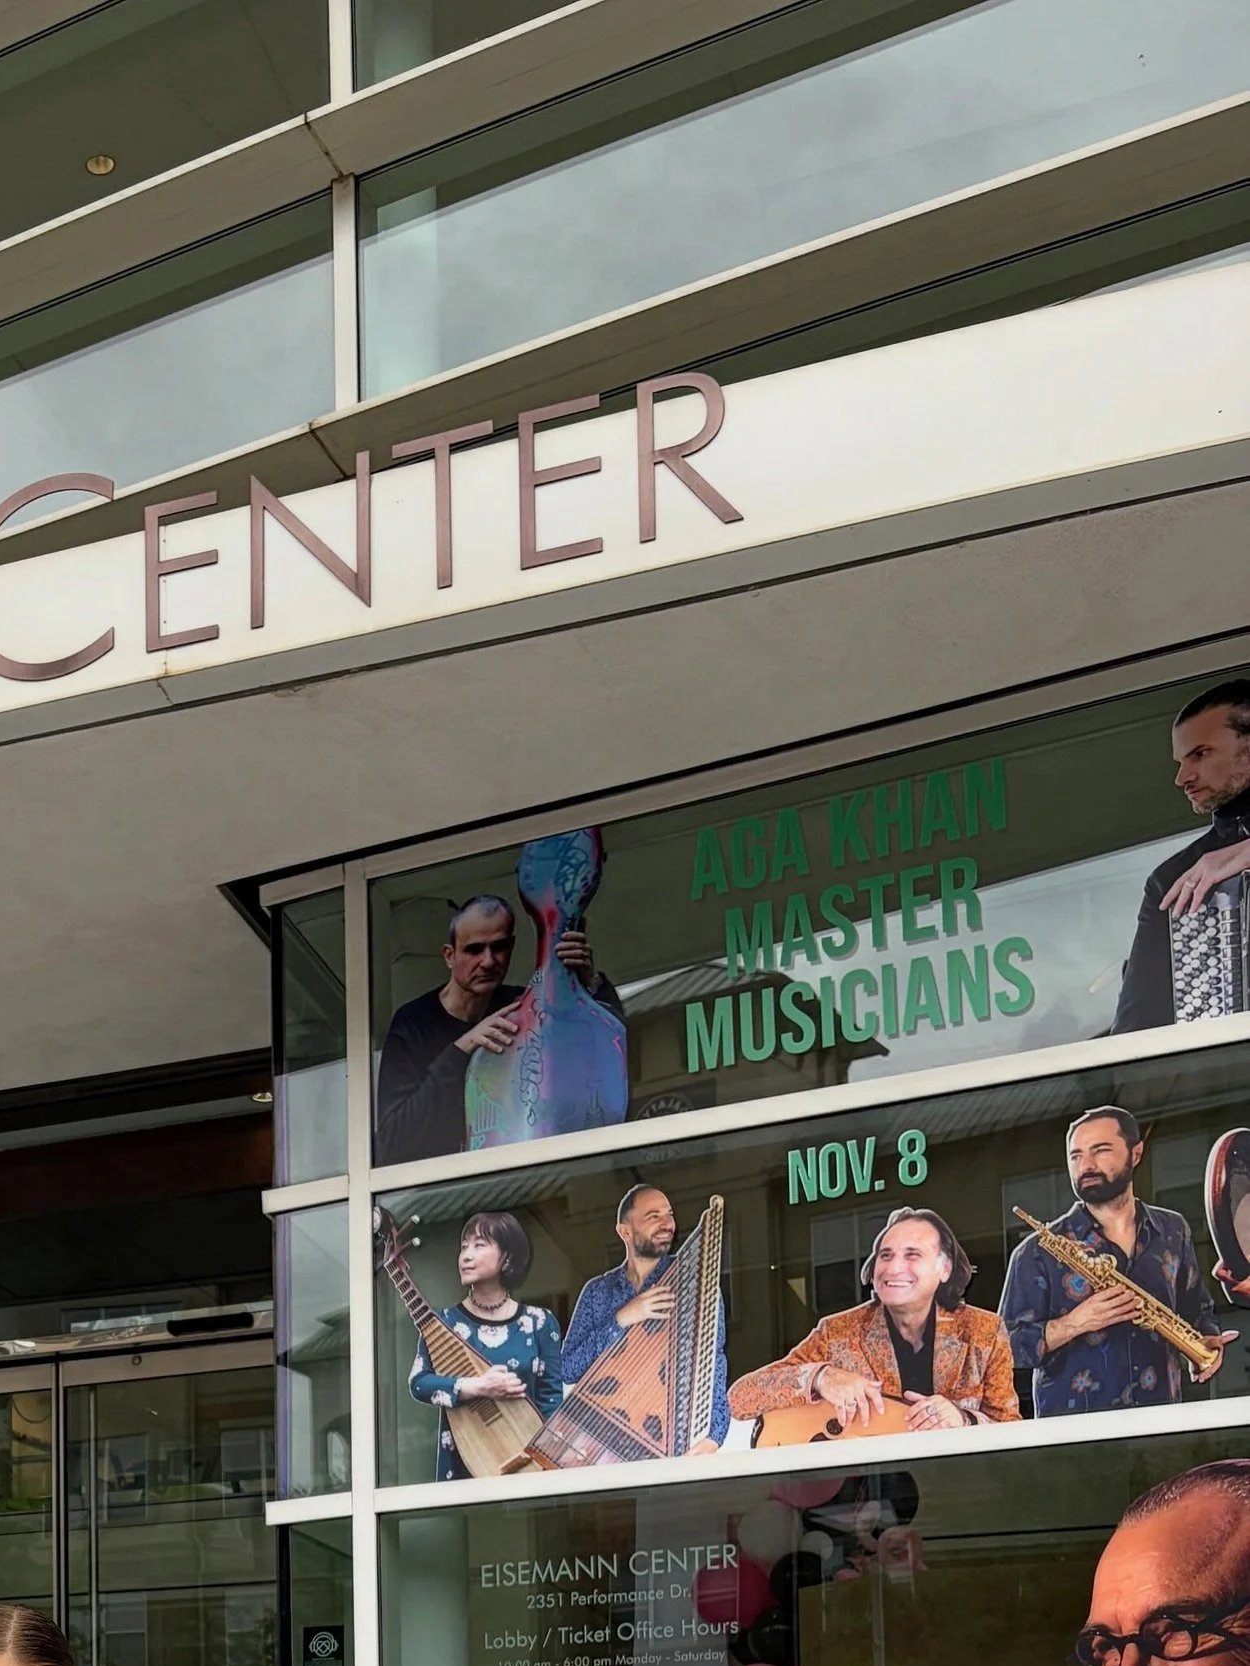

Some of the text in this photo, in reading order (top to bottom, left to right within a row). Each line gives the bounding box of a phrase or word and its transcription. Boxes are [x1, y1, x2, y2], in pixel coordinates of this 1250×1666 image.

[691, 757, 1008, 900] AGA KHAN
[724, 856, 983, 979] MASTER
[685, 936, 1035, 1073] MUSICIANS
[788, 1129, 928, 1205] NOV. 8
[481, 1544, 739, 1588] EISEMANN CENTER
[526, 1584, 691, 1609] 2351 Performance Dr.
[484, 1619, 739, 1652] Lobby / Ticket Office Hours
[615, 1653, 662, 1666] Monday
[674, 1648, 726, 1663] Saturday
